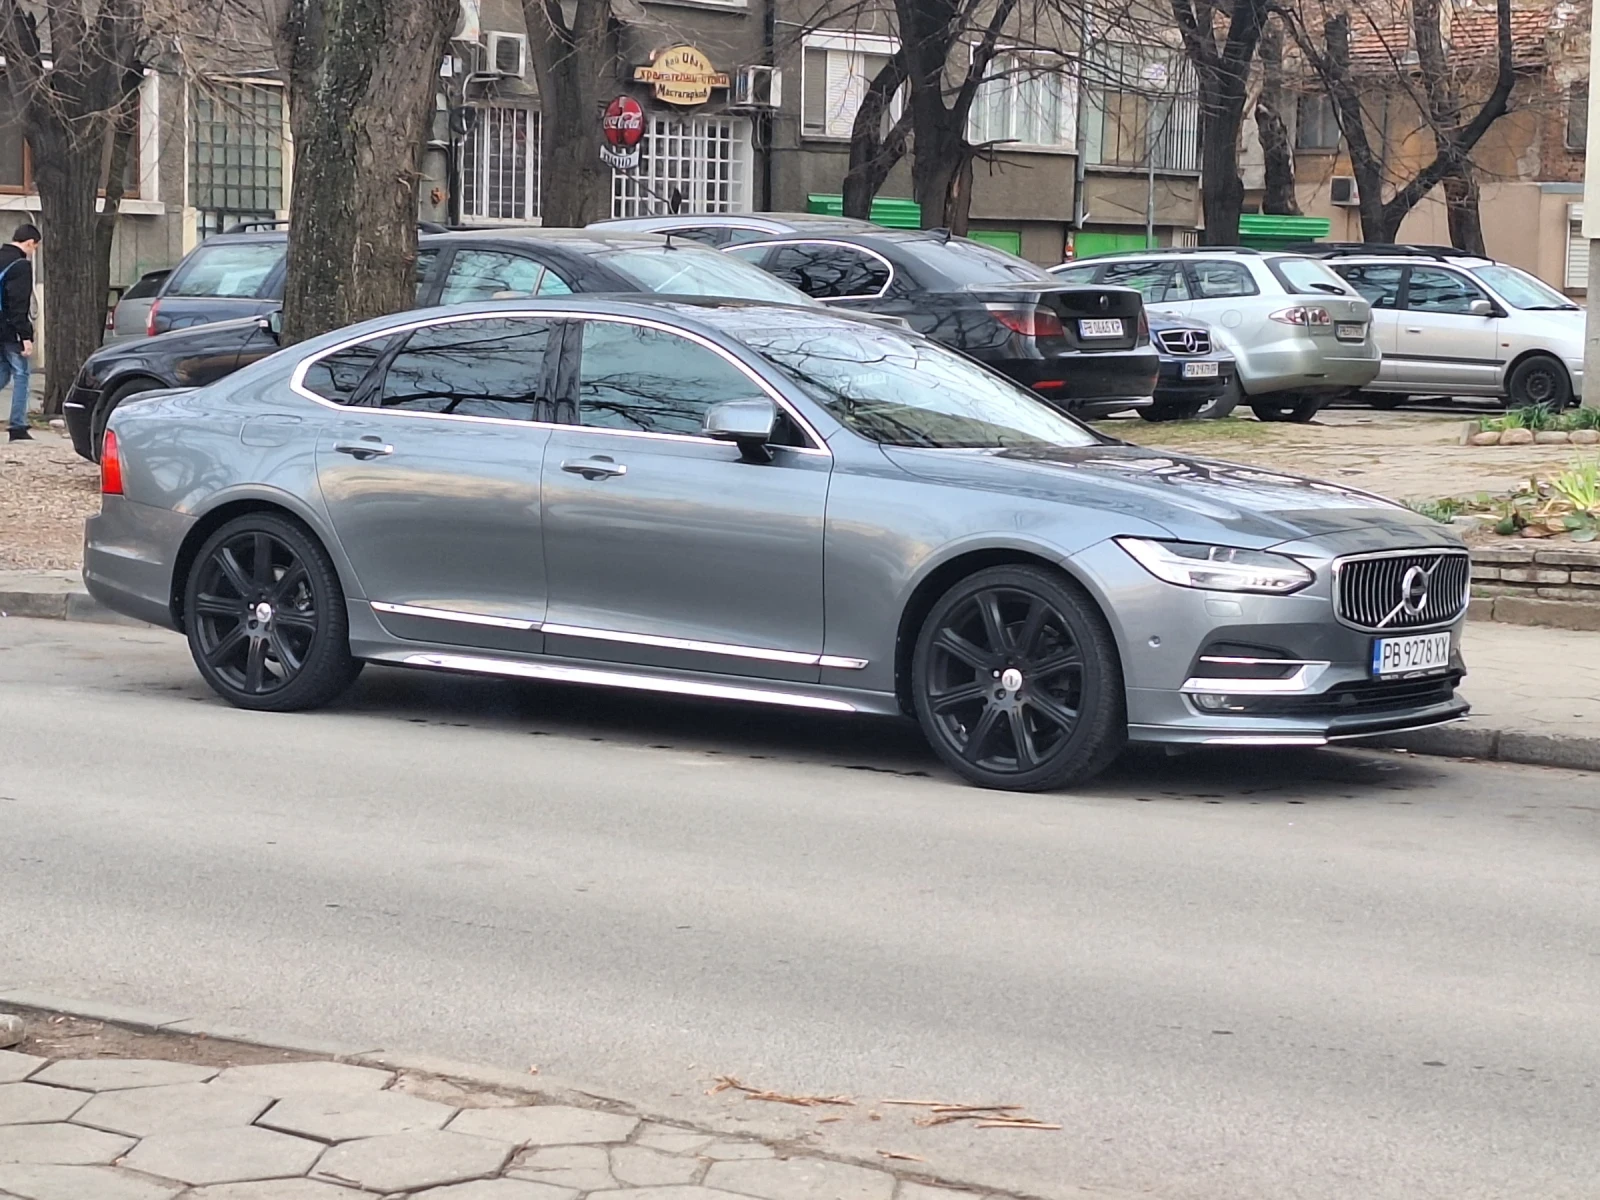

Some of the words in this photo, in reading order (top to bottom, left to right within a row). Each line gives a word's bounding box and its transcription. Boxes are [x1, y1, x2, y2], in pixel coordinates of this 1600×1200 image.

[1384, 642, 1401, 668] PB
[1404, 639, 1432, 666] 9278
[1434, 636, 1448, 662] XX
